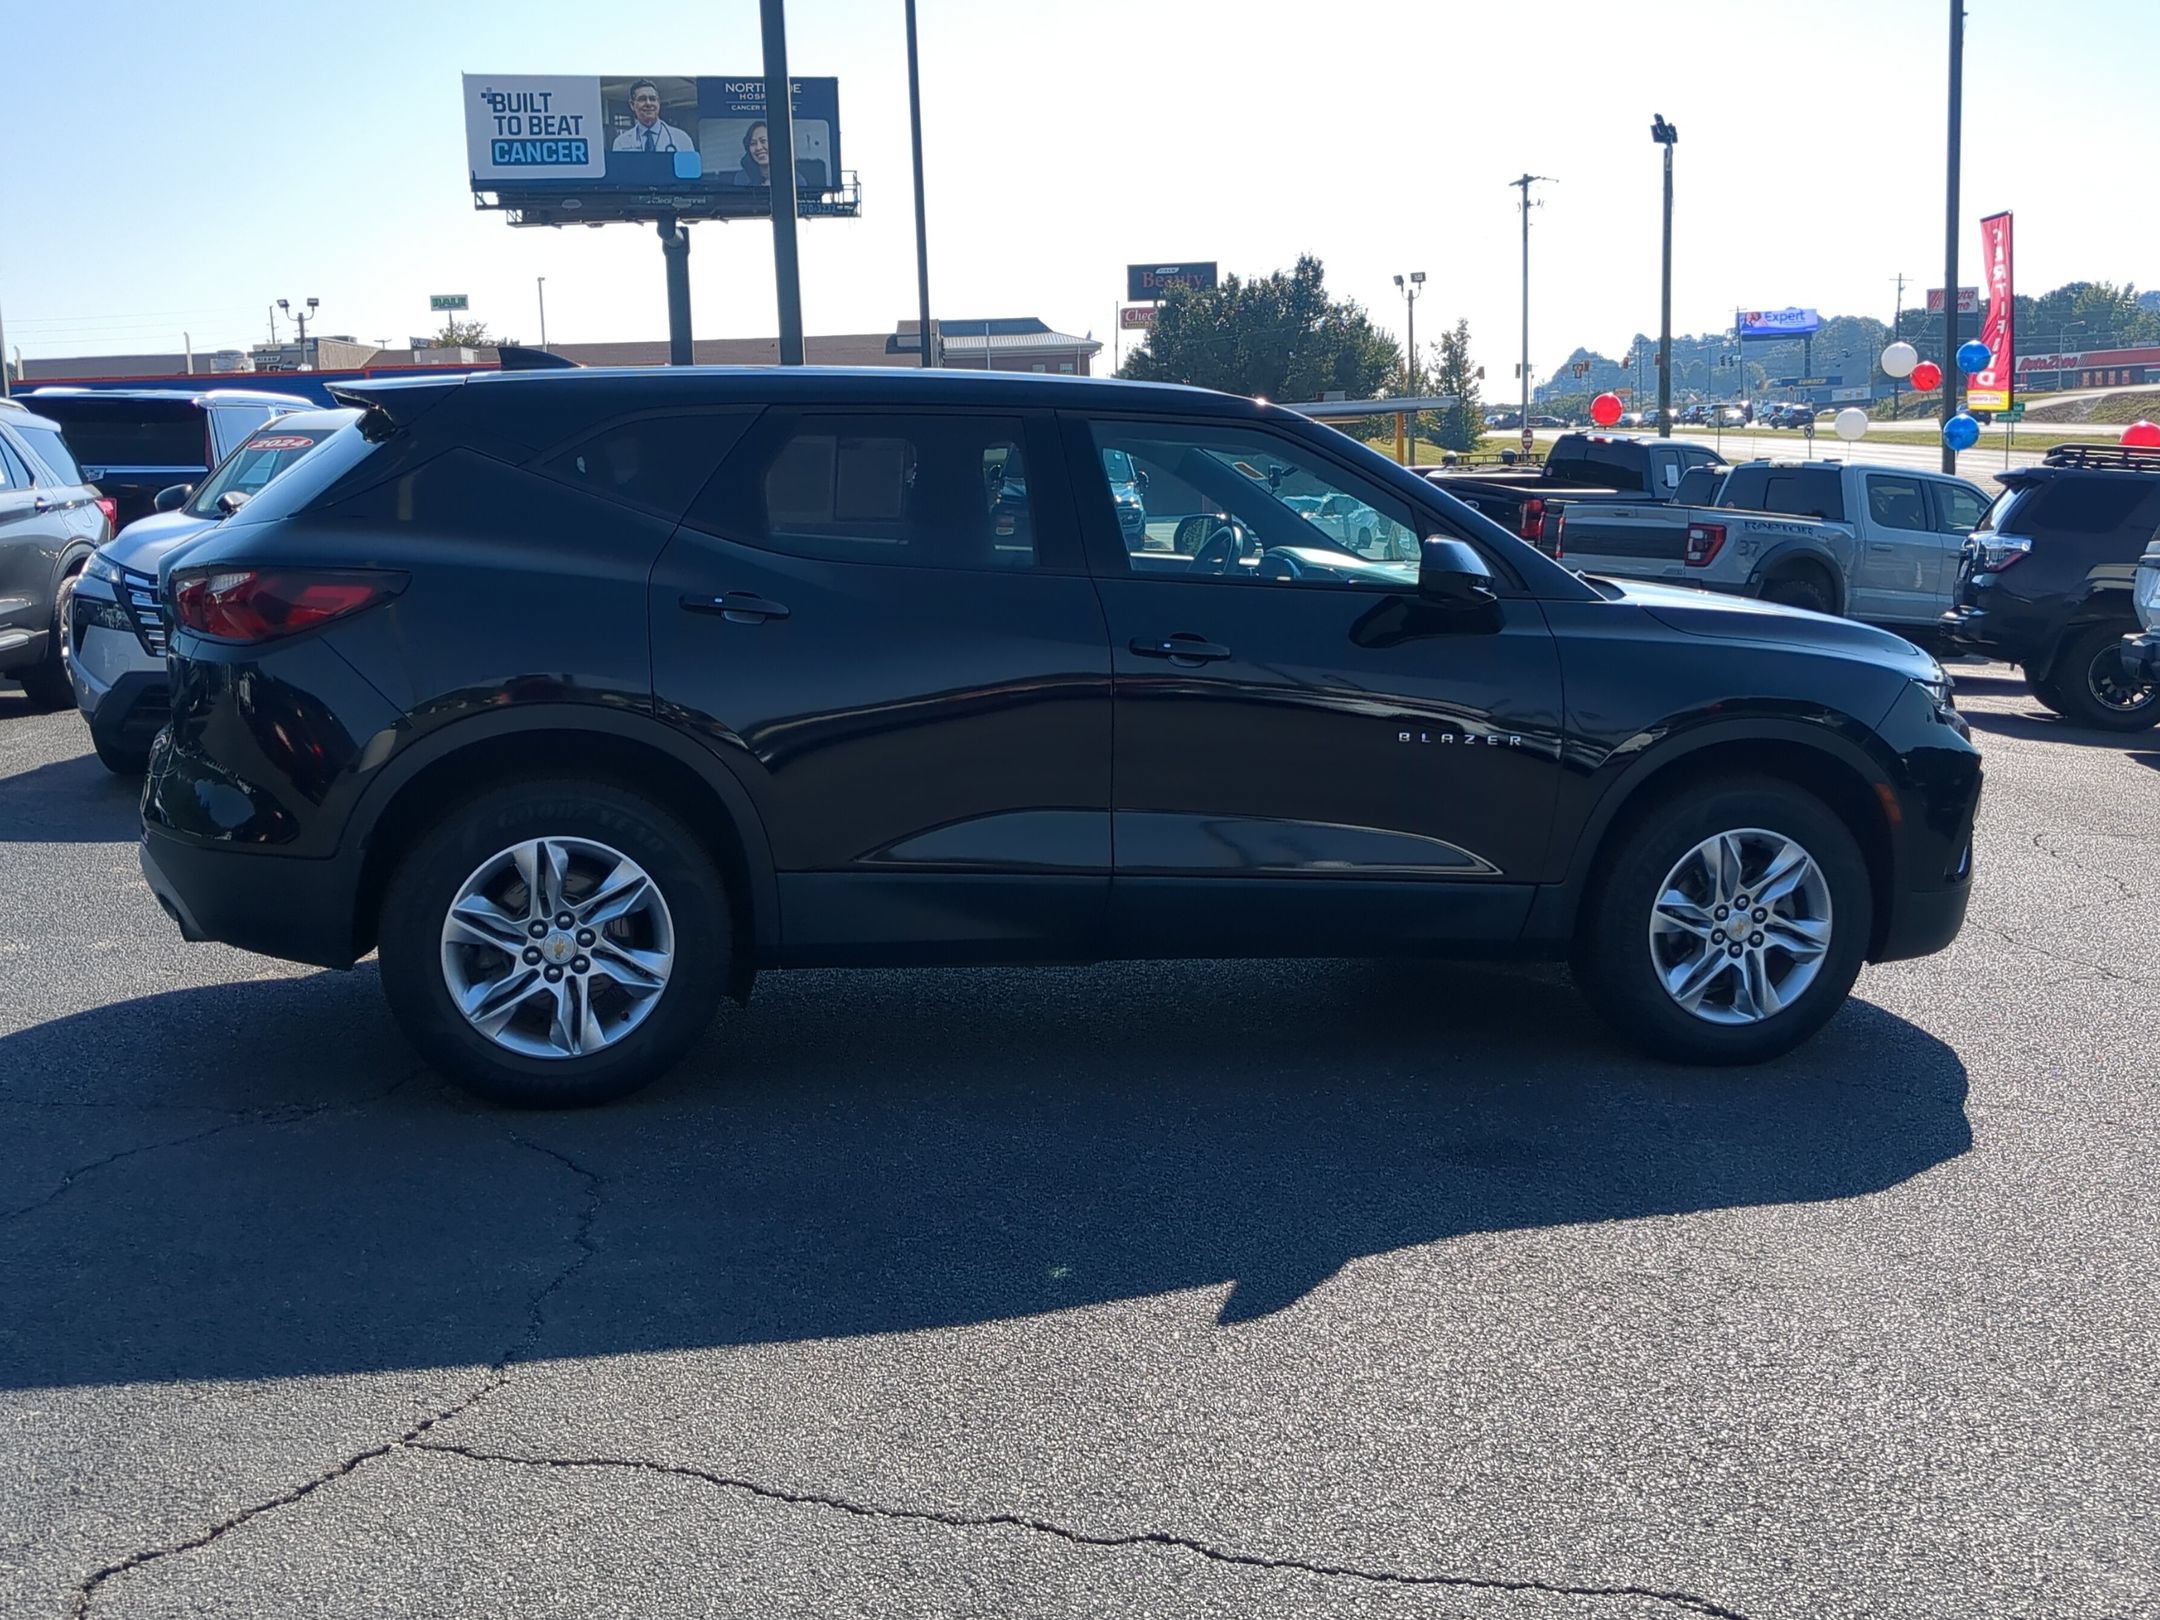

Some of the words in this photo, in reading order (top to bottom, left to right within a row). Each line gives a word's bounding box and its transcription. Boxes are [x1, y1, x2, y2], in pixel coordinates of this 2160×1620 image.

[725, 82, 802, 94] NORTE
[492, 92, 552, 113] BUILT
[493, 115, 522, 135] TO
[528, 115, 583, 135] BEAT
[494, 142, 586, 162] CANCER
[1765, 310, 1806, 324] Expert
[251, 438, 308, 448] 2024
[1744, 521, 1814, 535] RAPTOR
[1738, 540, 1760, 557] 37
[1399, 732, 1521, 746] BLAZER
